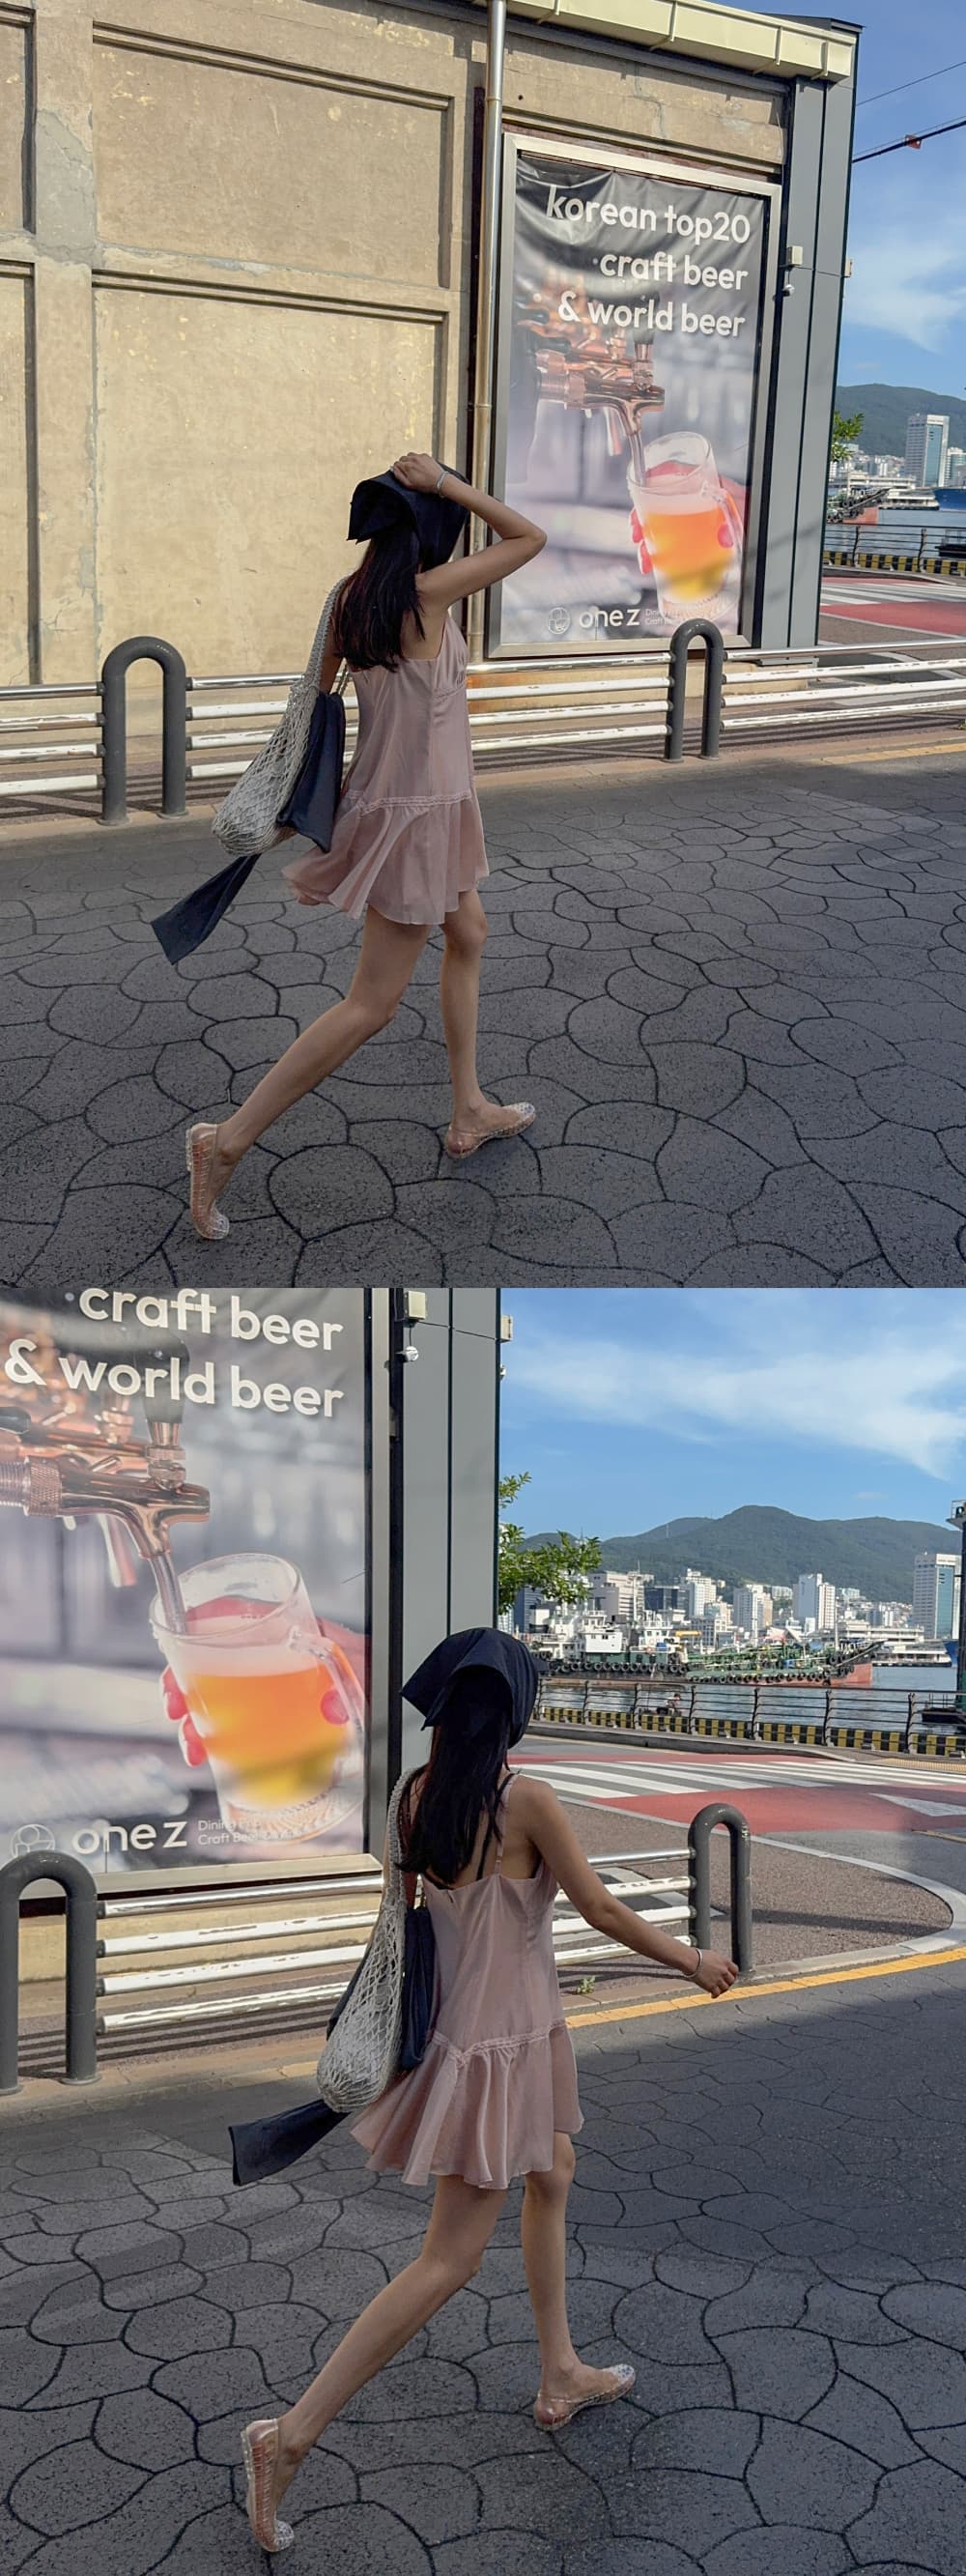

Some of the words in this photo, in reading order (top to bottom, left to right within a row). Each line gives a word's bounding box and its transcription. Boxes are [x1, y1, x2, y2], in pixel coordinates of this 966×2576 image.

[546, 185, 657, 232] korean
[664, 205, 751, 245] top20
[599, 251, 677, 283] craft
[684, 255, 749, 290] beer
[557, 290, 581, 323] &
[587, 299, 673, 331] world
[681, 302, 746, 337] beer
[79, 1287, 217, 1334] craft
[231, 1296, 344, 1351] beer
[4, 1338, 47, 1387] &
[58, 1358, 215, 1405] world
[231, 1365, 345, 1418] beer
[198, 1832, 230, 1846] Craft
